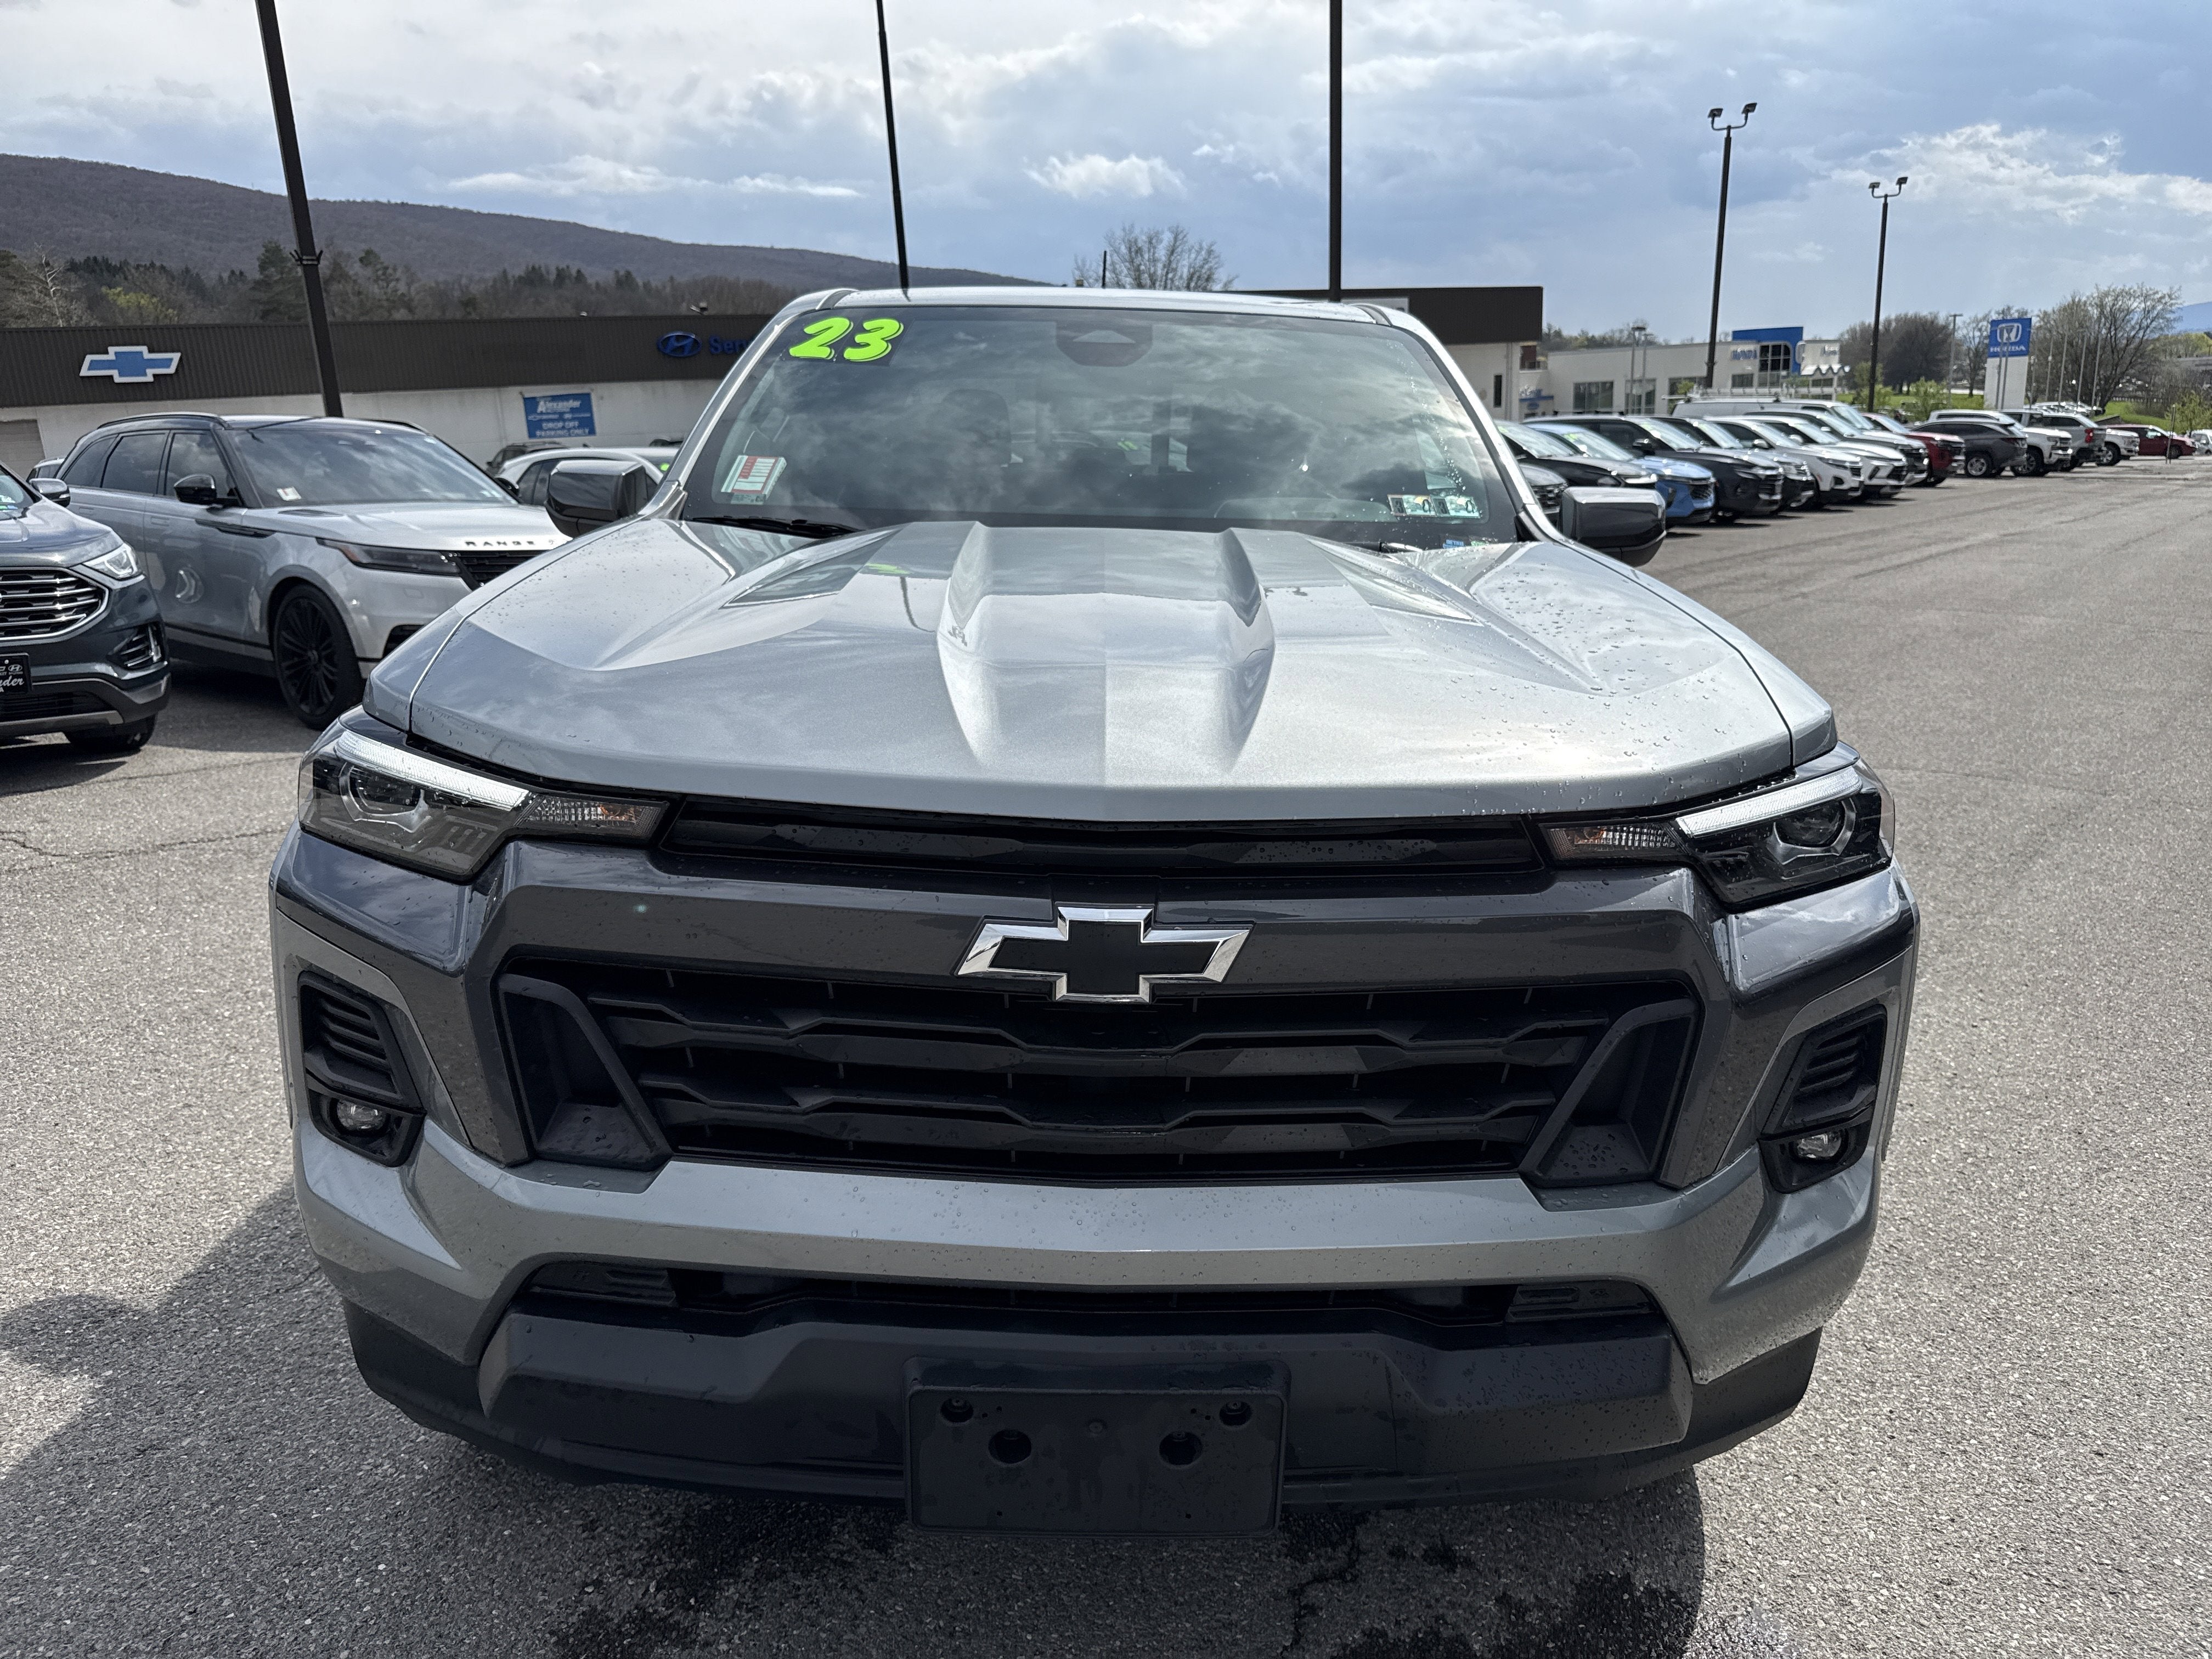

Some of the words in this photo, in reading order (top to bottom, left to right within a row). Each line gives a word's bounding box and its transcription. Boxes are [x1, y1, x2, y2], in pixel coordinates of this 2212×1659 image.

[789, 317, 904, 362] 23
[541, 421, 563, 430] DROP
[564, 420, 579, 428] OFF
